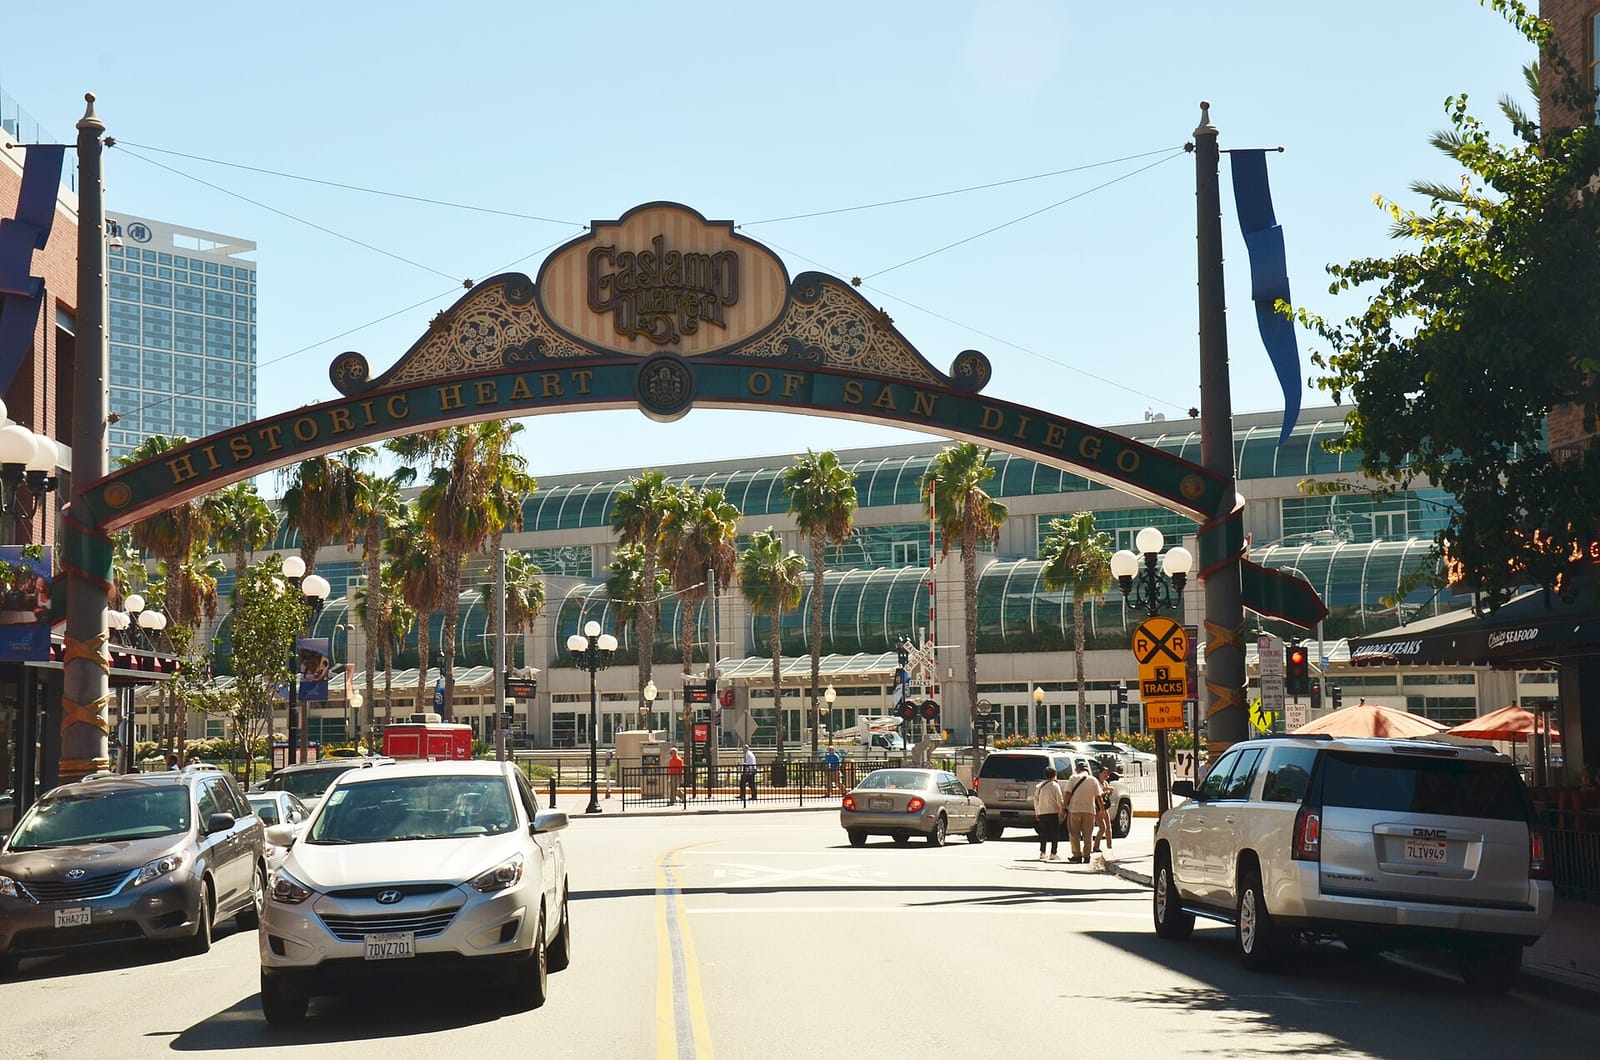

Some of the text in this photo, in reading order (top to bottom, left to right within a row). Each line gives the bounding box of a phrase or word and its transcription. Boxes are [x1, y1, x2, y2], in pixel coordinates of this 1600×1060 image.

[587, 234, 739, 313] Gaslamp
[614, 286, 727, 344] Quarter
[166, 370, 1141, 485] HISTORIC HEART OF SAN DIEGO
[1505, 628, 1539, 644] SEAFOOD
[1137, 637, 1184, 652] R R
[1388, 640, 1423, 655] STEAKS
[904, 641, 934, 672] RAILROAD
[1159, 669, 1167, 680] 3
[1144, 683, 1183, 693] TRACKS
[1159, 706, 1170, 714] NO
[1413, 828, 1447, 839] GMC
[1407, 846, 1445, 860] 7LIV949
[57, 914, 89, 925] 7KHA273
[367, 942, 411, 956] 7DVZ701
